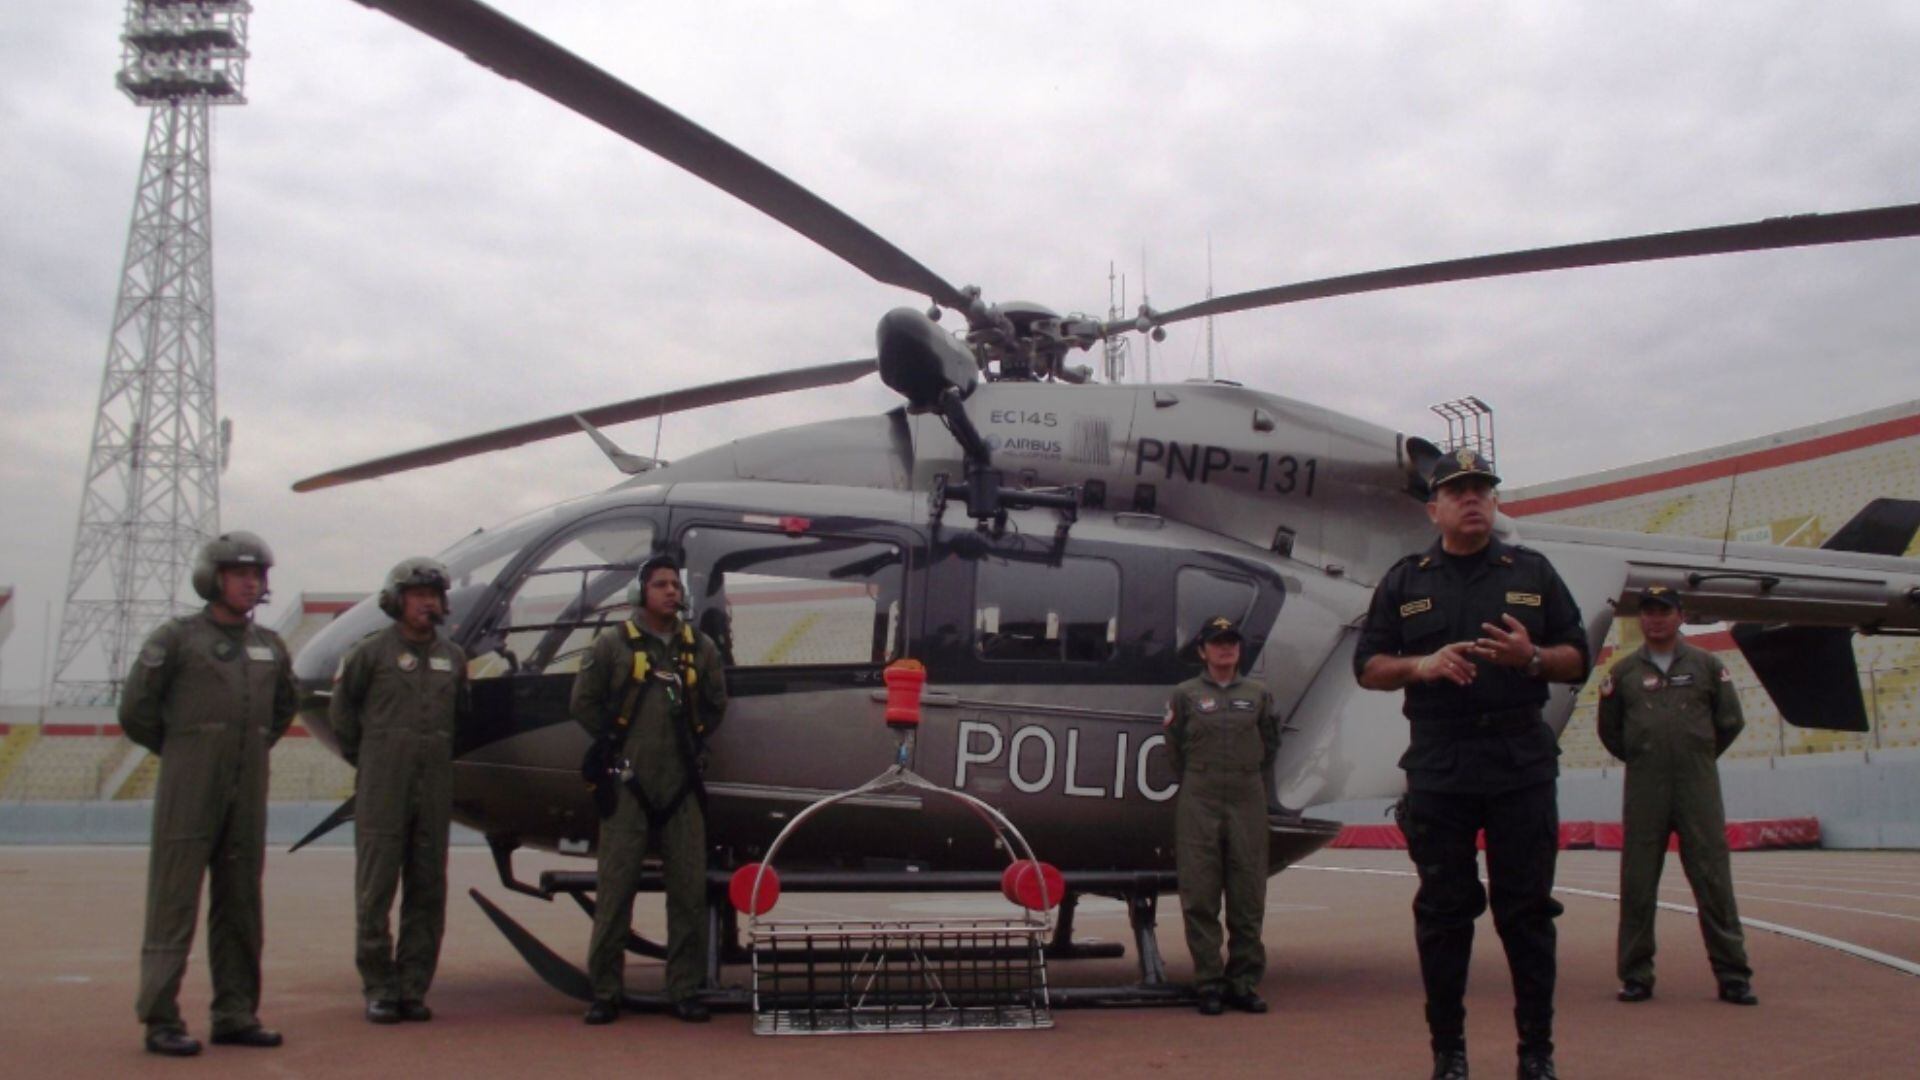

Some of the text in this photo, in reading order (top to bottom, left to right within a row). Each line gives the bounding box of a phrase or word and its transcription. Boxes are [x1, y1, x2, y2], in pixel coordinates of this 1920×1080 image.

[990, 409, 1058, 428] EC145
[1004, 437, 1062, 453] AIRBUS
[1136, 438, 1318, 497] PNP-131
